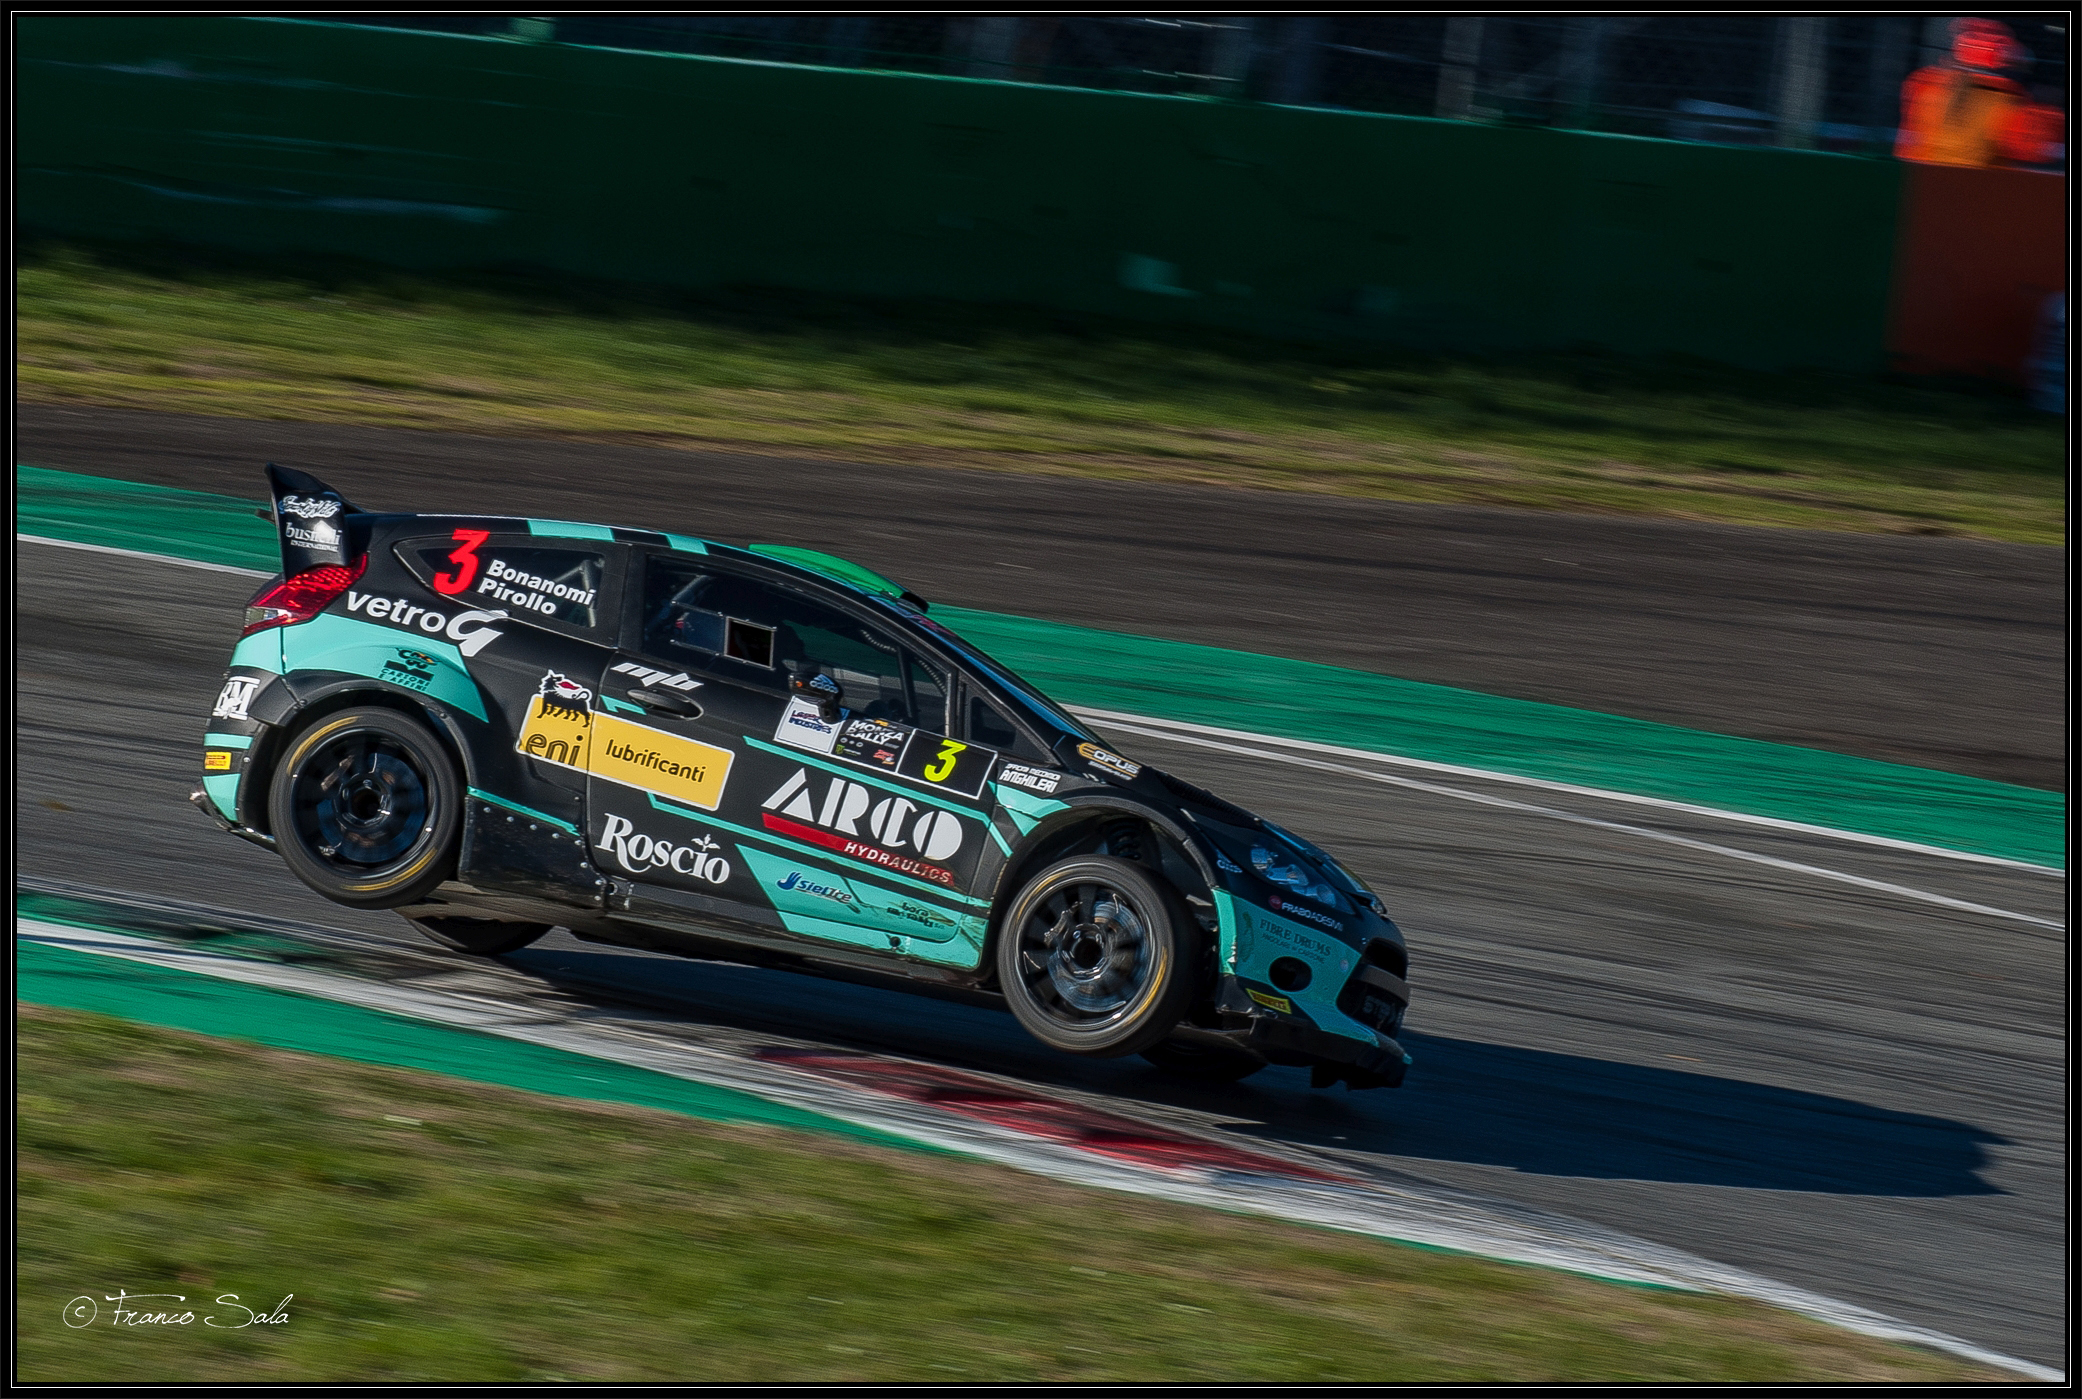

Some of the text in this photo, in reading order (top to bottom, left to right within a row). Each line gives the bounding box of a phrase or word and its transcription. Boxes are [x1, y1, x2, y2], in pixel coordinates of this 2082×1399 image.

[433, 528, 490, 594] 3
[486, 559, 597, 605] Bonanomi
[477, 578, 557, 615] Pirollo
[526, 733, 584, 767] eni
[605, 739, 707, 783] lubrificanti
[924, 739, 967, 782] 3
[1094, 750, 1140, 774] OPUS
[999, 769, 1059, 794] ANGHILERI
[761, 767, 963, 861] ARCO
[594, 813, 730, 884] Roscio
[844, 841, 952, 884] HYDRAULICS
[1260, 918, 1332, 956] FIBRE DRUMS
